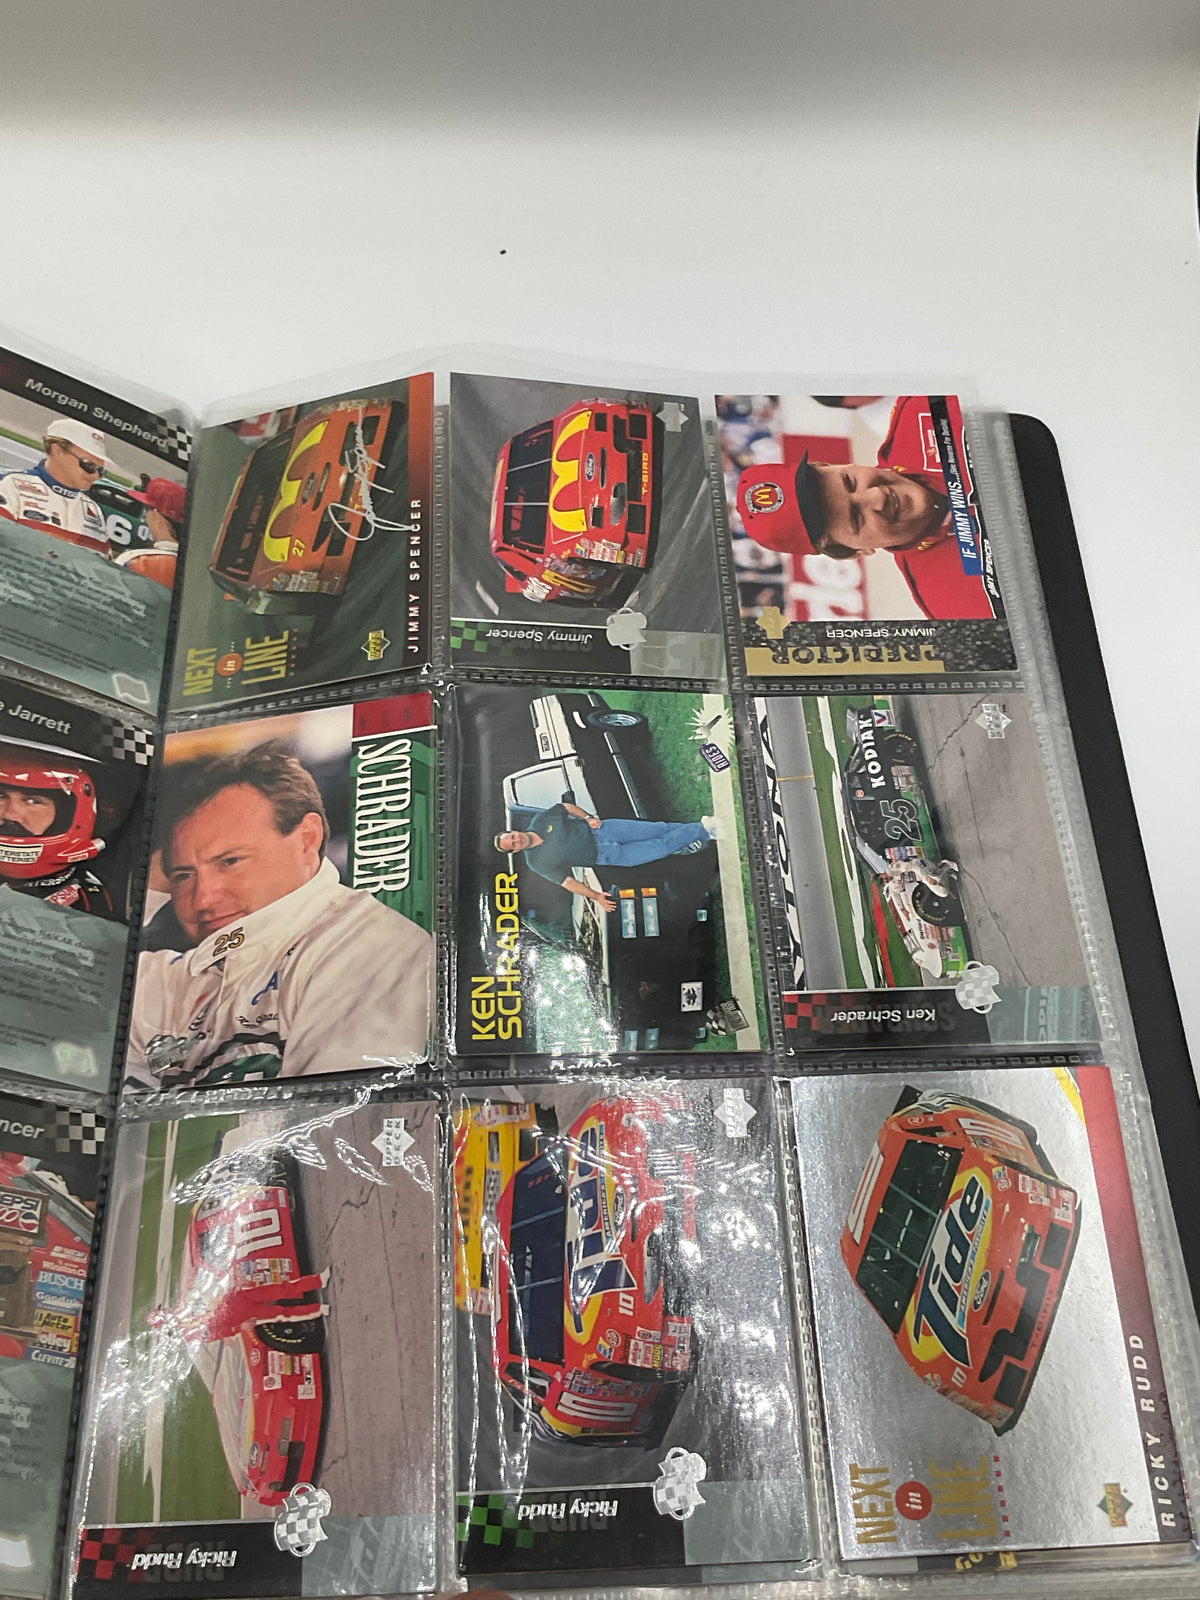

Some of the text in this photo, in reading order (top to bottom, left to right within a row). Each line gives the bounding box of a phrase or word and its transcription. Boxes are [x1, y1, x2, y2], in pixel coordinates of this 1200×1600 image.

[25, 378, 170, 448] Morgan Shepherd
[585, 458, 595, 477] Ford
[954, 510, 975, 547] JIMMY
[292, 539, 305, 557] 27
[962, 548, 977, 559] IF
[407, 499, 422, 653] JIMMY SPENCER
[485, 629, 593, 645] Jimmy Spencer
[826, 627, 936, 639] JIMMY SPENCER
[183, 648, 217, 696] NEXT
[223, 660, 236, 671] in
[241, 630, 289, 685] LINE
[8, 704, 72, 735] Jarrett
[859, 718, 886, 789] KODIAK
[353, 738, 412, 894] SCHRADER
[880, 799, 923, 842] 25
[213, 926, 245, 957] 25
[495, 872, 523, 1040] SCHRADER
[471, 975, 497, 1040] KEN
[830, 1008, 935, 1023] Ken Schrader
[385, 1119, 393, 1166] UPPER
[393, 1120, 401, 1165] DECK
[614, 1192, 626, 1227] Ford
[847, 1143, 884, 1245] 10
[233, 1207, 282, 1260] 10
[38, 1270, 86, 1291] BUSCH
[914, 1175, 987, 1369] Tide
[618, 1292, 634, 1316] 10
[975, 1275, 989, 1306] Ford
[607, 1331, 620, 1346] STP
[952, 1367, 967, 1388] 10
[557, 1391, 637, 1422] 10
[1129, 1333, 1176, 1528] RICKY RUDD
[517, 1498, 619, 1521] Ricky Rudd
[849, 1462, 898, 1544] NEXT
[904, 1490, 922, 1513] in
[929, 1456, 999, 1540] LINE
[131, 1547, 238, 1571] Ricky Rudd
